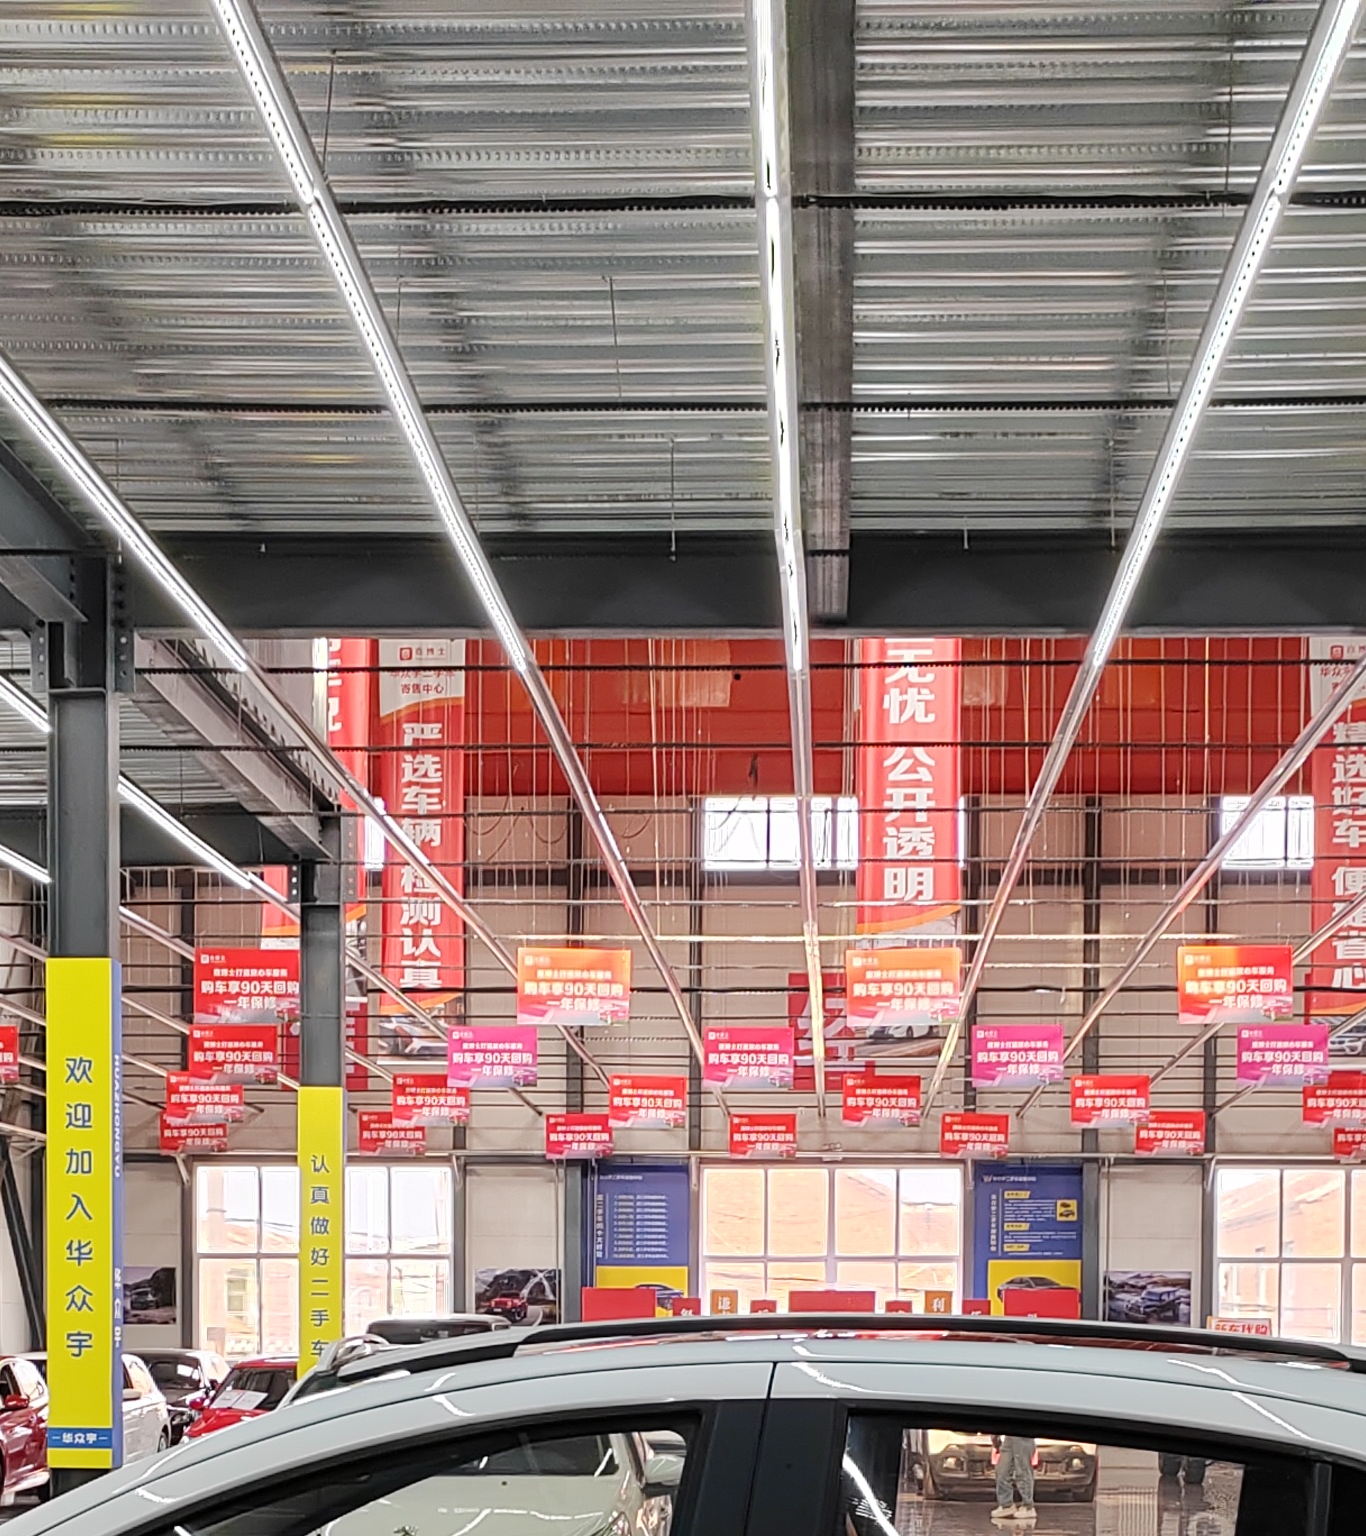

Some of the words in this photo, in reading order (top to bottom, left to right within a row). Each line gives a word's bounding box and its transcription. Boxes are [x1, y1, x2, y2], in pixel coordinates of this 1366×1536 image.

[883, 638, 936, 724] 无忧
[401, 723, 443, 847] 严选车辆
[883, 746, 936, 905] 公开透明
[400, 865, 443, 989] 检测认真
[201, 980, 299, 994] 购车享90天回购
[524, 982, 623, 996] 购车享90天回购
[853, 982, 954, 996] 购车享90天回购
[1185, 979, 1287, 994] 购车享90天回购
[223, 996, 276, 1009] 一年保修
[547, 998, 600, 1010] 一年保修
[876, 998, 931, 1010] 一年保修
[1209, 994, 1263, 1008] 一年保修
[193, 1051, 273, 1062] 购车享90天回购
[452, 1052, 533, 1064] 购车享90天回购
[708, 1053, 789, 1065] 购车享90天回购
[977, 1051, 1058, 1063] 购车享90天回购
[1241, 1051, 1323, 1063] 购车享90天回购
[171, 1094, 239, 1103] 购车享90天回购
[397, 1096, 465, 1106] 购车享90天回购
[613, 1097, 682, 1108] 购车享90天回购
[847, 1097, 916, 1107] 购车享90天回购
[1075, 1097, 1145, 1108] 购车享90天回购
[65, 1055, 93, 1358] 欢迎加入华众宇
[310, 1154, 330, 1358] 认真做好二手车
[61, 1432, 97, 1445] 华众宇
